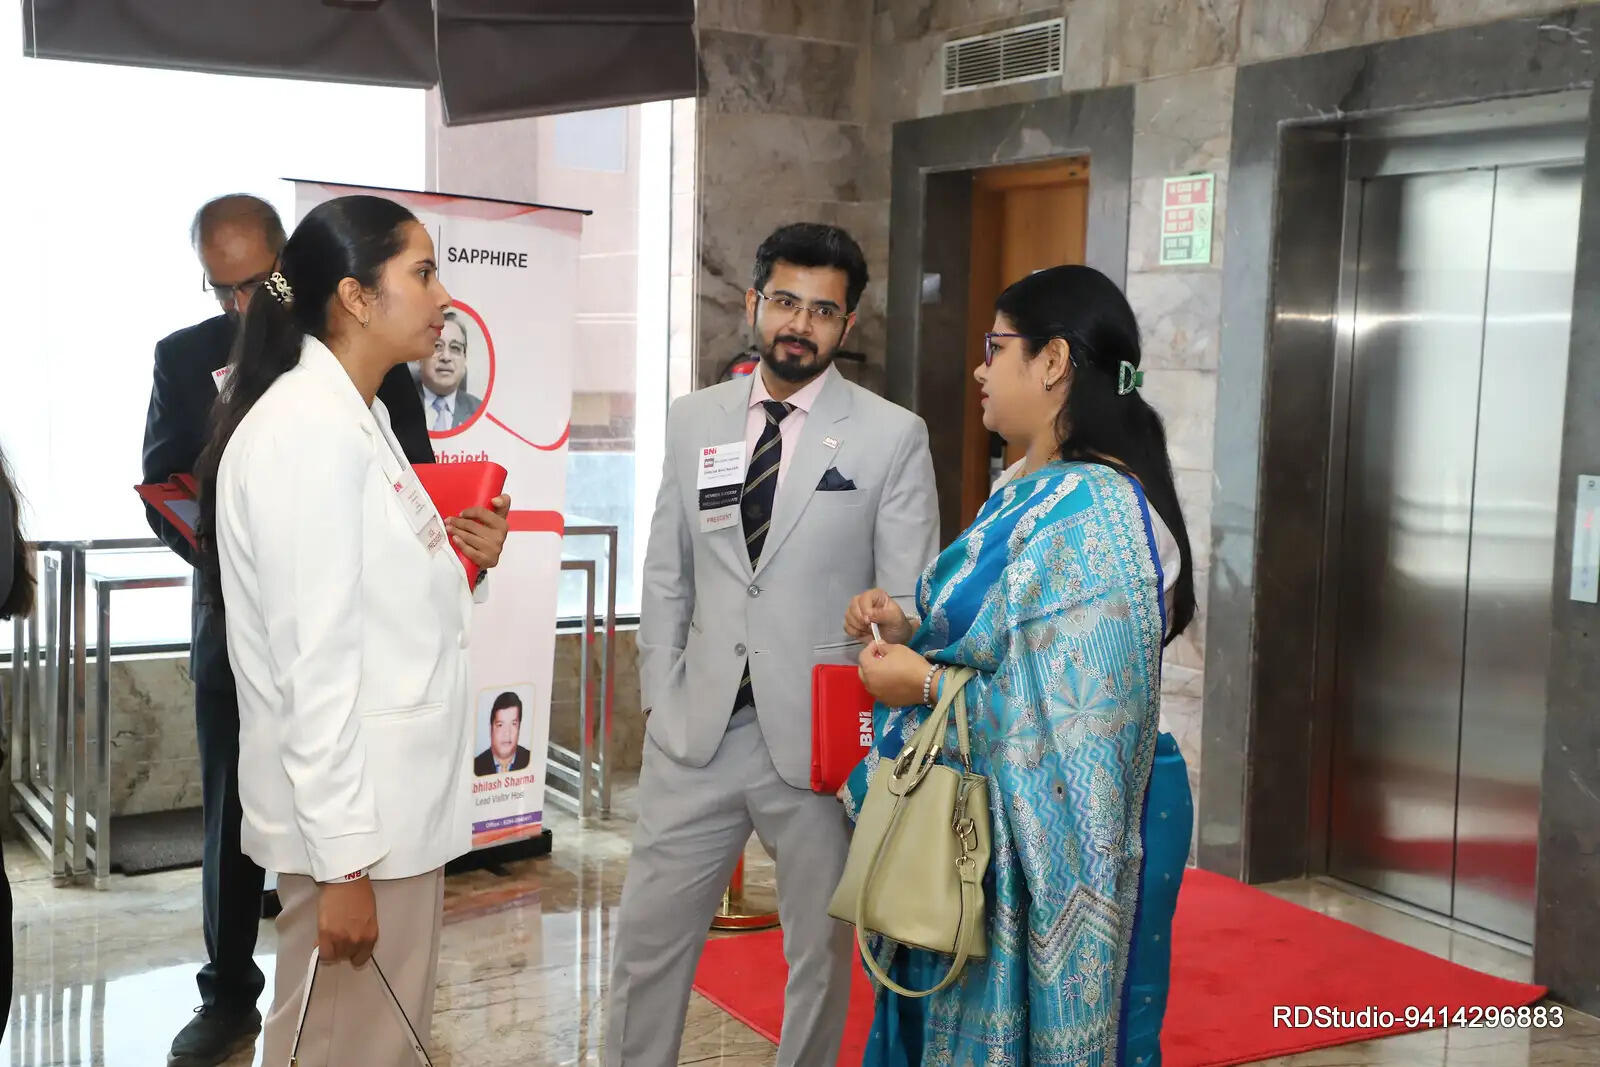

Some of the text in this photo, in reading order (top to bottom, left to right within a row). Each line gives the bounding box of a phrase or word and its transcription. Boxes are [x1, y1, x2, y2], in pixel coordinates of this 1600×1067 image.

[447, 246, 528, 269] SAPPHIRE
[472, 774, 535, 794] bhilash Sharma
[475, 796, 491, 806] Lead
